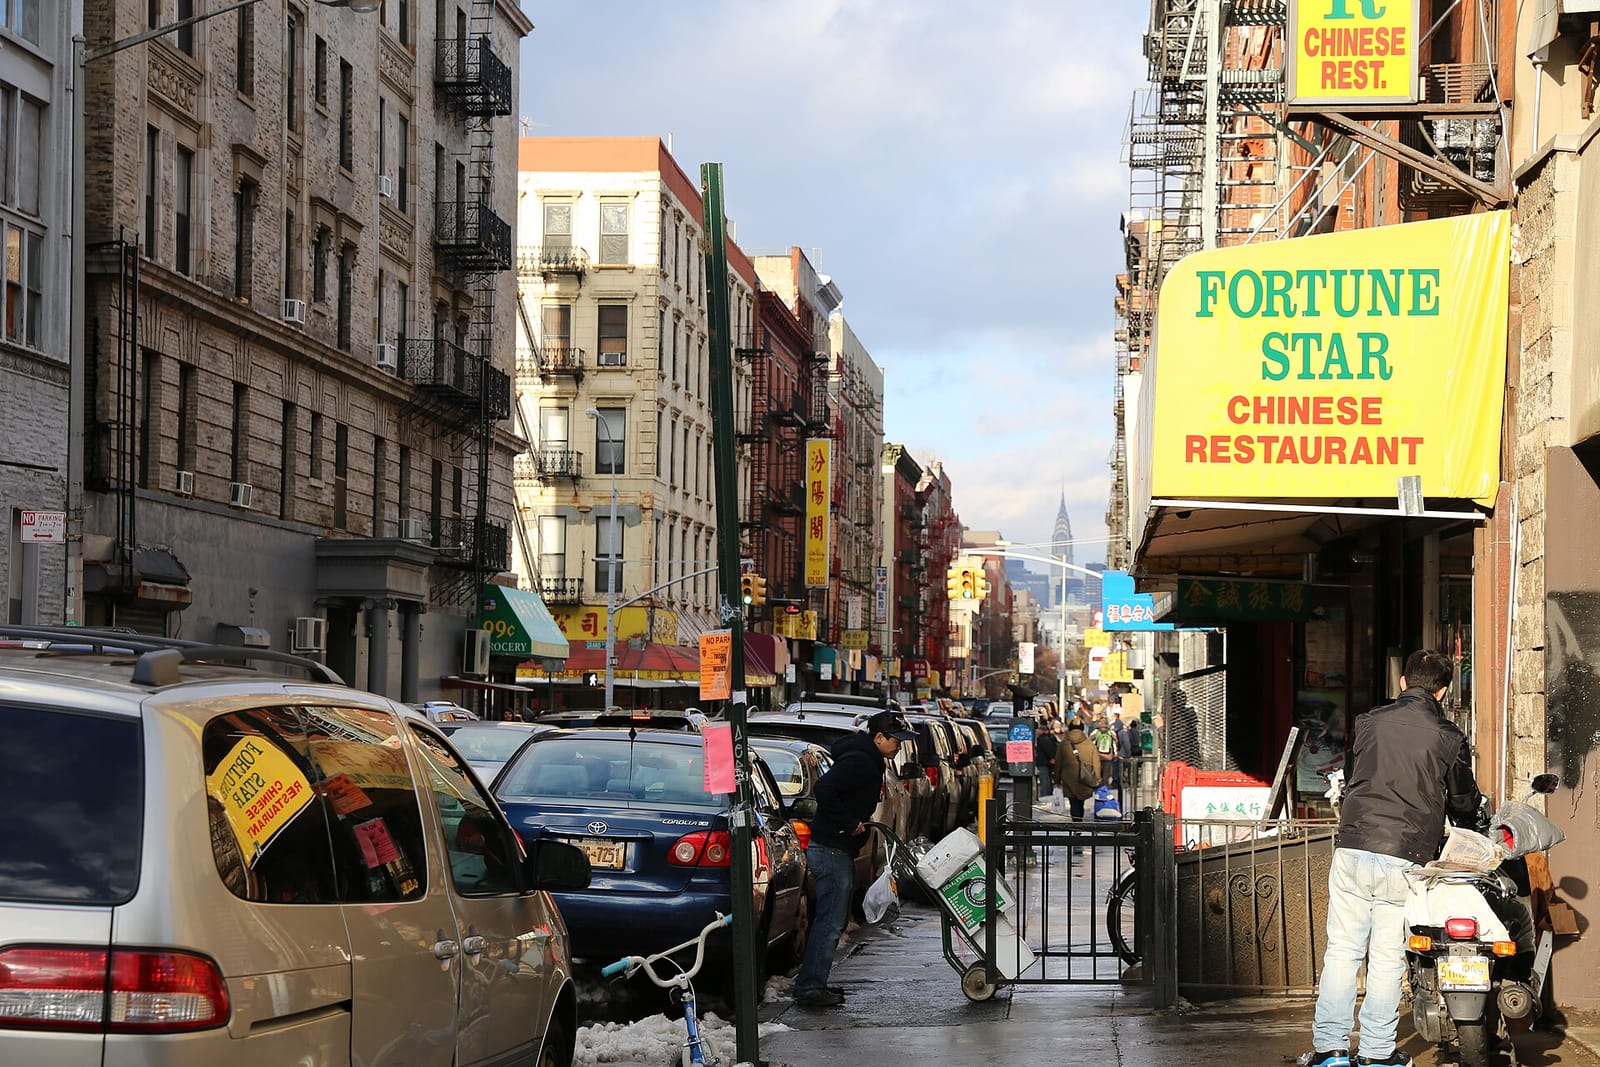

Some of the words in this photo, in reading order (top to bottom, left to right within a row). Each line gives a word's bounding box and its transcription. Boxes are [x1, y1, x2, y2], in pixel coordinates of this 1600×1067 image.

[1304, 27, 1406, 57] CHINESE
[1321, 60, 1387, 89] REST.
[1195, 269, 1440, 318] FORTUNE
[1261, 331, 1393, 381] STAR
[1227, 395, 1383, 425] CHINESE
[1185, 435, 1424, 465] RESTAURANT
[23, 513, 35, 524] NO
[706, 637, 715, 645] NO
[662, 818, 697, 826] COROLLA
